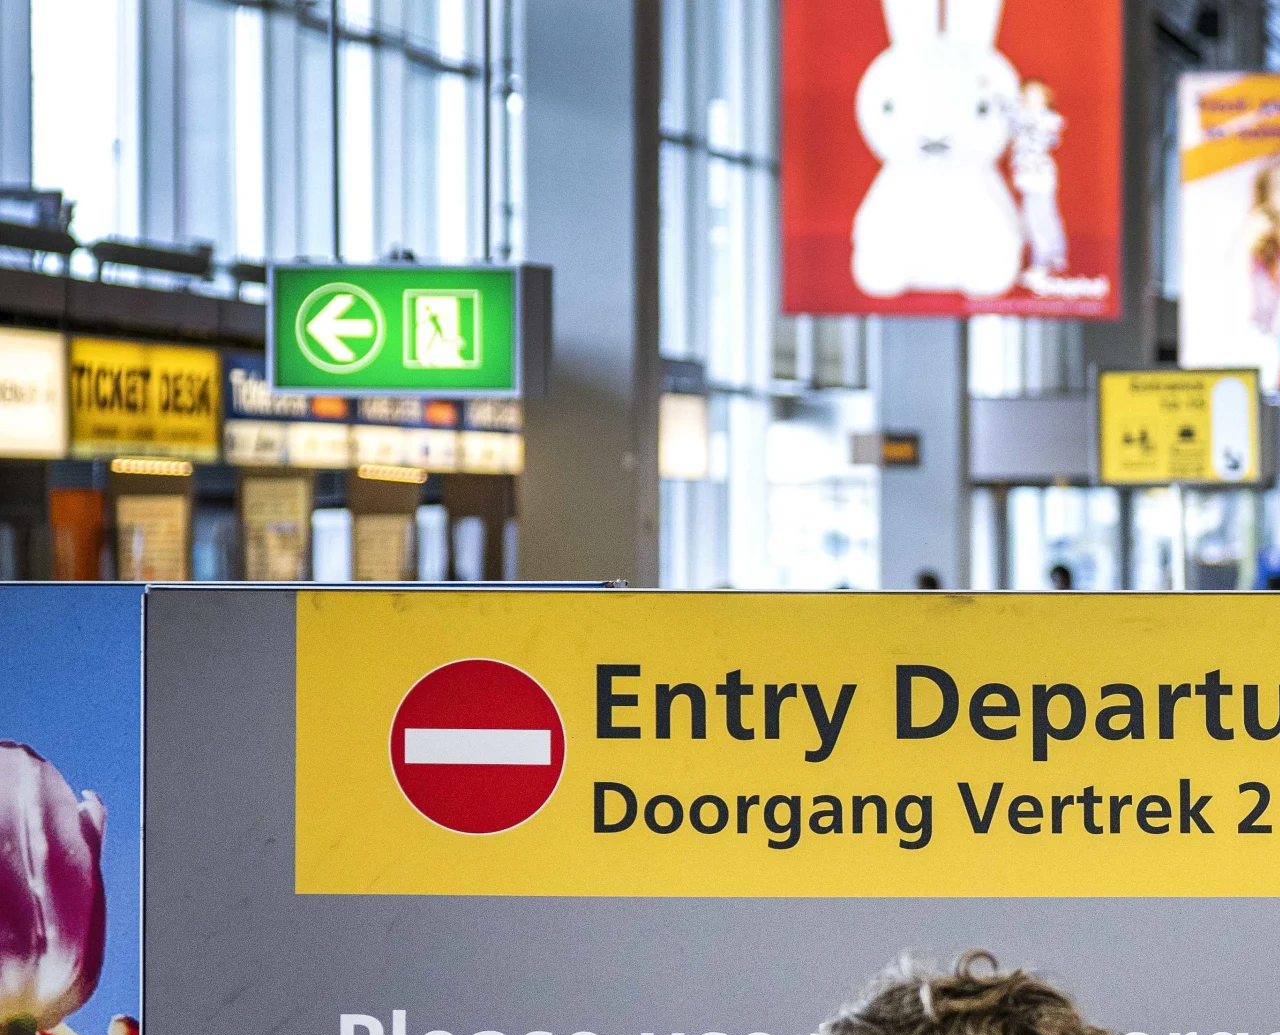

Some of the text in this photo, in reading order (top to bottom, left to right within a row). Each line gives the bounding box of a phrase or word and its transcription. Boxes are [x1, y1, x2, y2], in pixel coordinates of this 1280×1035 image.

[71, 364, 151, 413] TICKET
[158, 368, 214, 418] DESK
[597, 664, 856, 762] Entry
[594, 782, 933, 850] Doorgang
[958, 779, 1213, 835] Vertrek
[1238, 782, 1272, 834] 2
